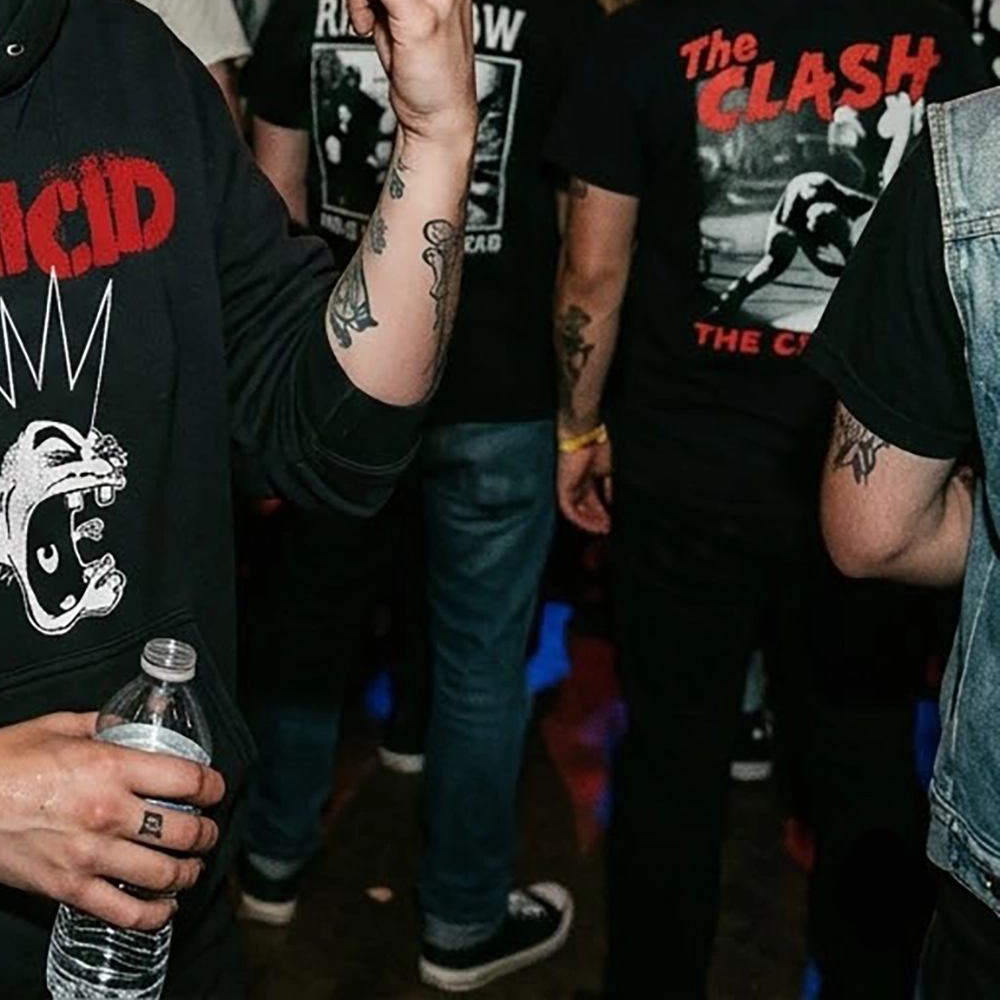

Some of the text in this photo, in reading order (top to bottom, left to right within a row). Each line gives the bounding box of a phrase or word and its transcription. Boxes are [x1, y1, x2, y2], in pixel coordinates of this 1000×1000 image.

[679, 28, 759, 80] The
[696, 34, 941, 132] CLASH
[693, 321, 761, 354] THE
